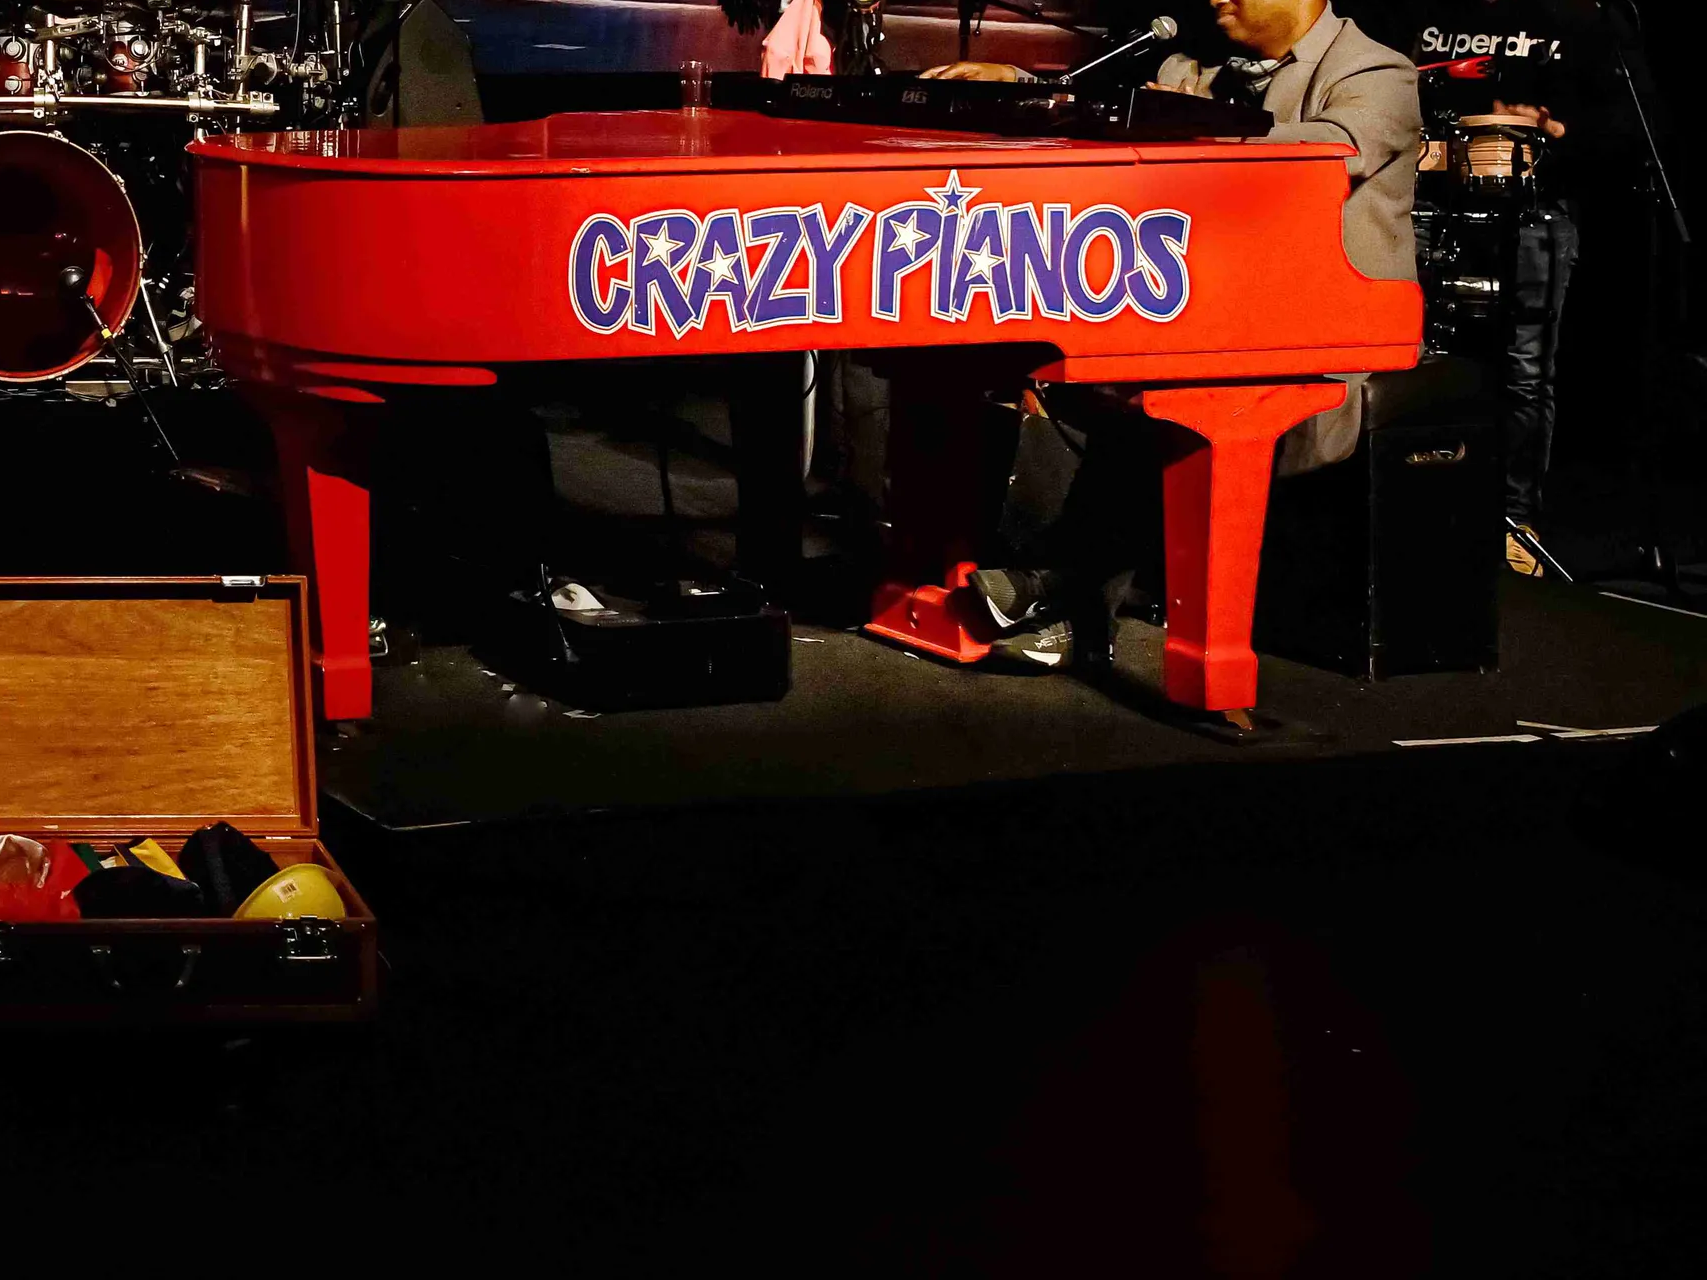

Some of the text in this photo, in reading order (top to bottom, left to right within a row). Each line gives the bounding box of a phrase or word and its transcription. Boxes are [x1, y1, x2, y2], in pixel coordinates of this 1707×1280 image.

[790, 82, 834, 99] Roland
[568, 169, 1191, 340] CRAZY PIANOS
